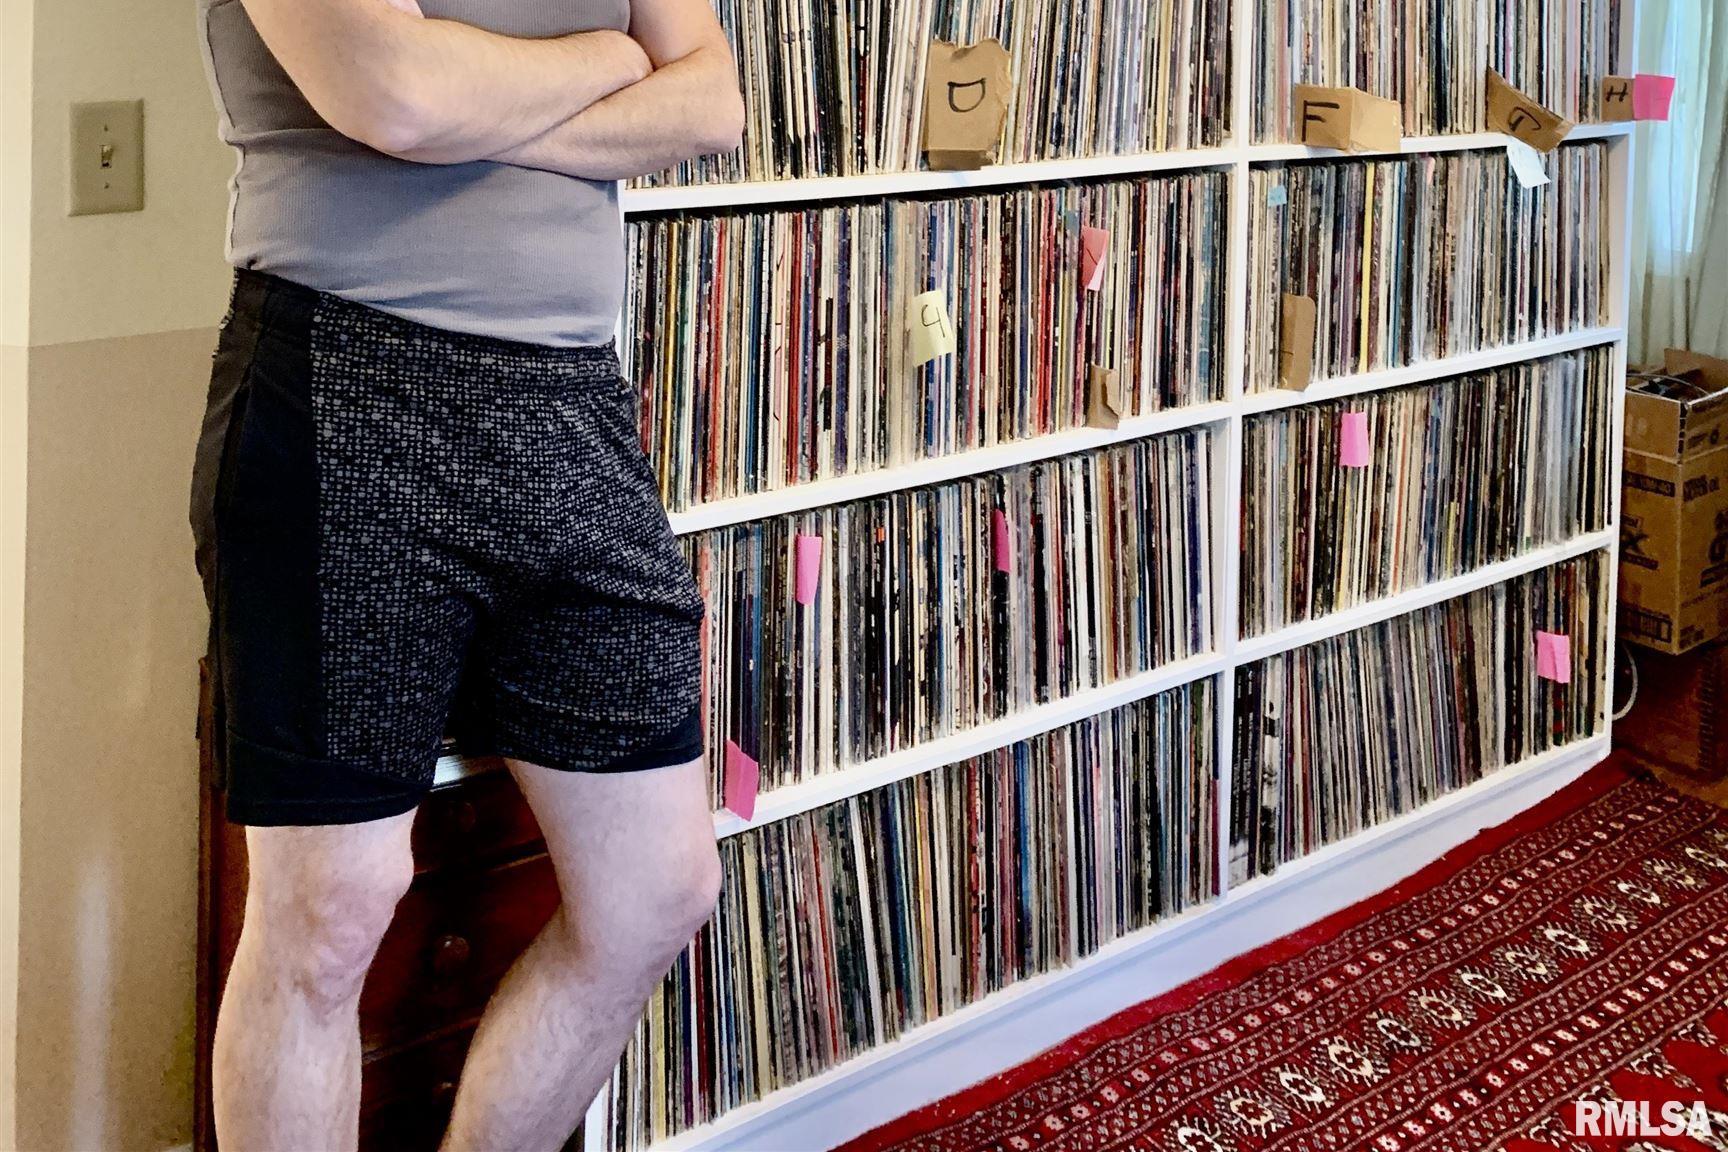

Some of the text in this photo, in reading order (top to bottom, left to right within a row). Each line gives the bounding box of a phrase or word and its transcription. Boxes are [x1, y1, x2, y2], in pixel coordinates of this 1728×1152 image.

[947, 77, 987, 113] D
[1605, 82, 1628, 103] H
[1301, 100, 1340, 142] F
